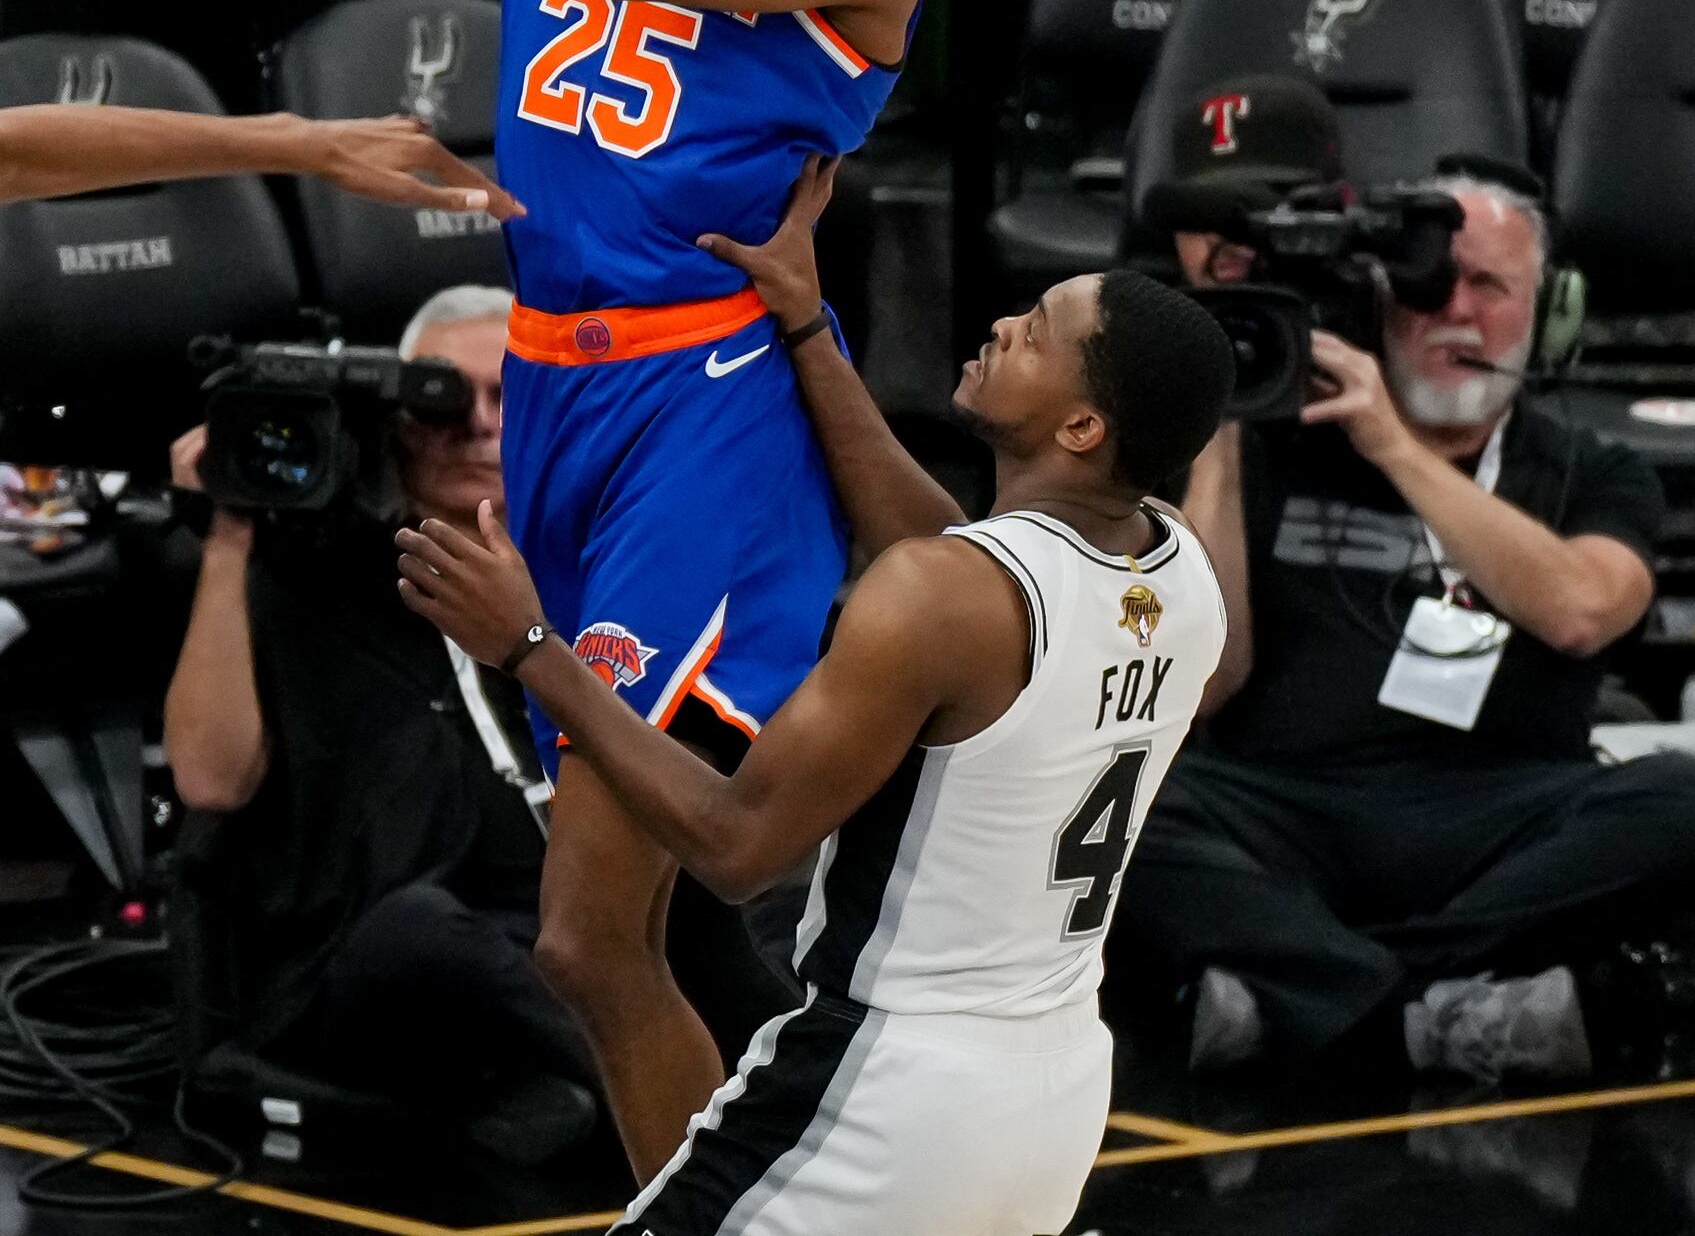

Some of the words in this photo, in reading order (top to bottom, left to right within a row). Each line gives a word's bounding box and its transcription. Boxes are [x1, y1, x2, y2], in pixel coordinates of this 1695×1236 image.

[1202, 93, 1250, 155] T
[1095, 656, 1173, 730] FOX
[1046, 739, 1152, 944] 4
